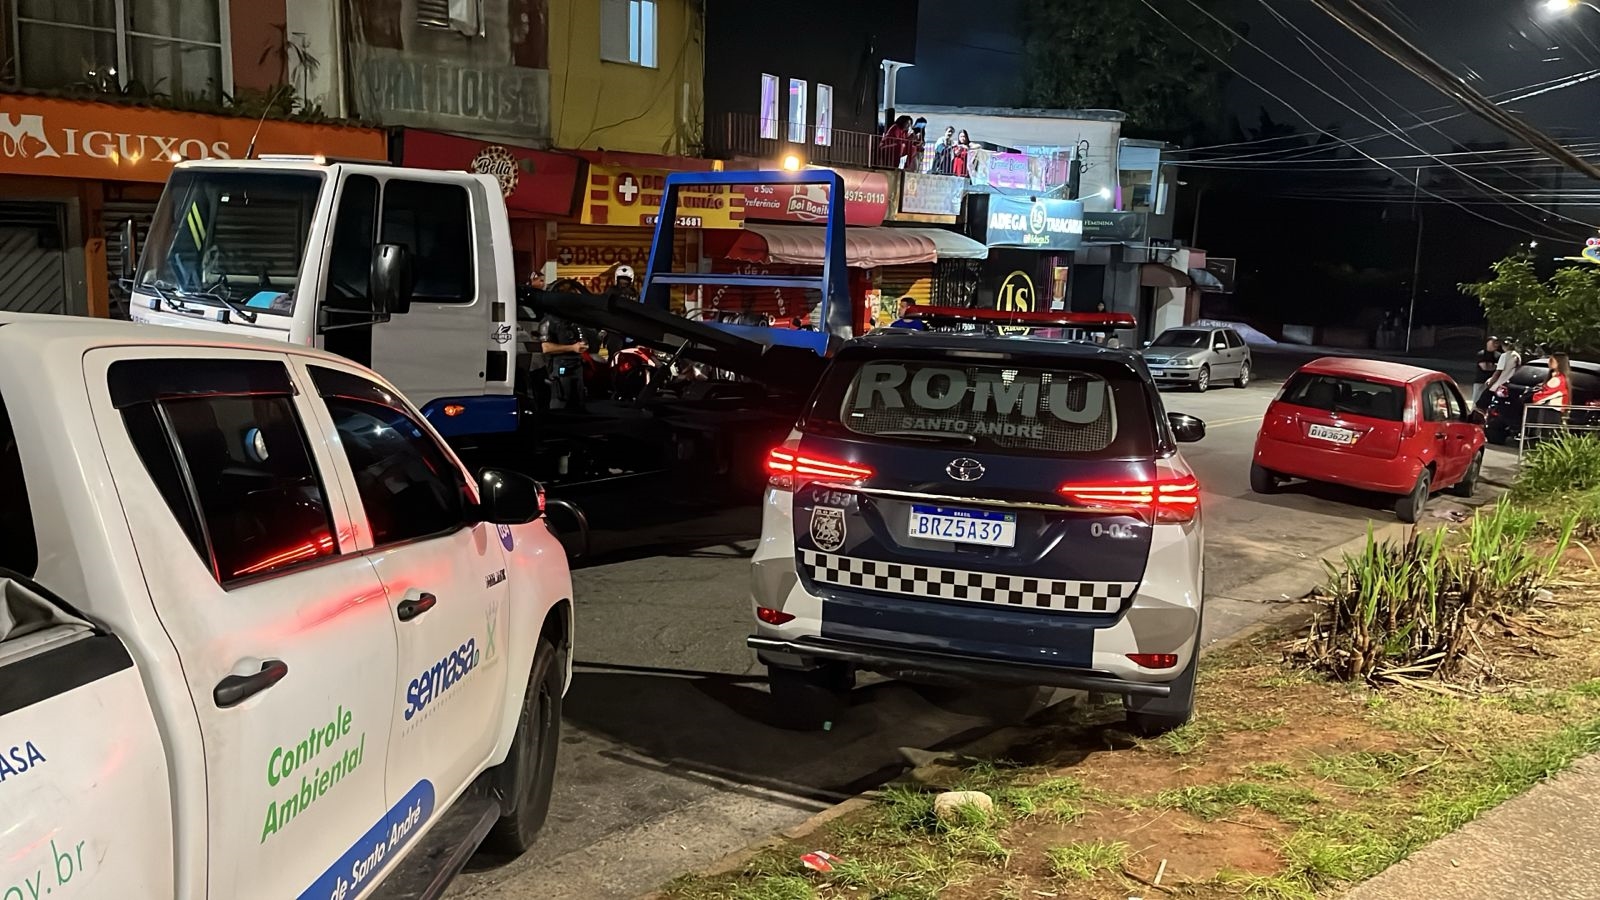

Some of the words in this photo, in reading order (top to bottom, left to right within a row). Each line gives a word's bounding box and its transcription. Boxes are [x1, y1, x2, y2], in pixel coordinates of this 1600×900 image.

[807, 201, 829, 215] Bonit
[989, 212, 1028, 231] ADEGA
[855, 363, 1106, 425] ROMU
[902, 415, 970, 433] SANTO
[974, 421, 1044, 440] ANDRÉ
[919, 516, 1002, 541] BRZ5A39
[404, 638, 475, 721] semasa
[267, 704, 353, 788] Controle
[260, 731, 366, 845] Ambiental
[330, 876, 348, 900] de
[350, 842, 387, 891] Santo
[387, 798, 422, 852] André
